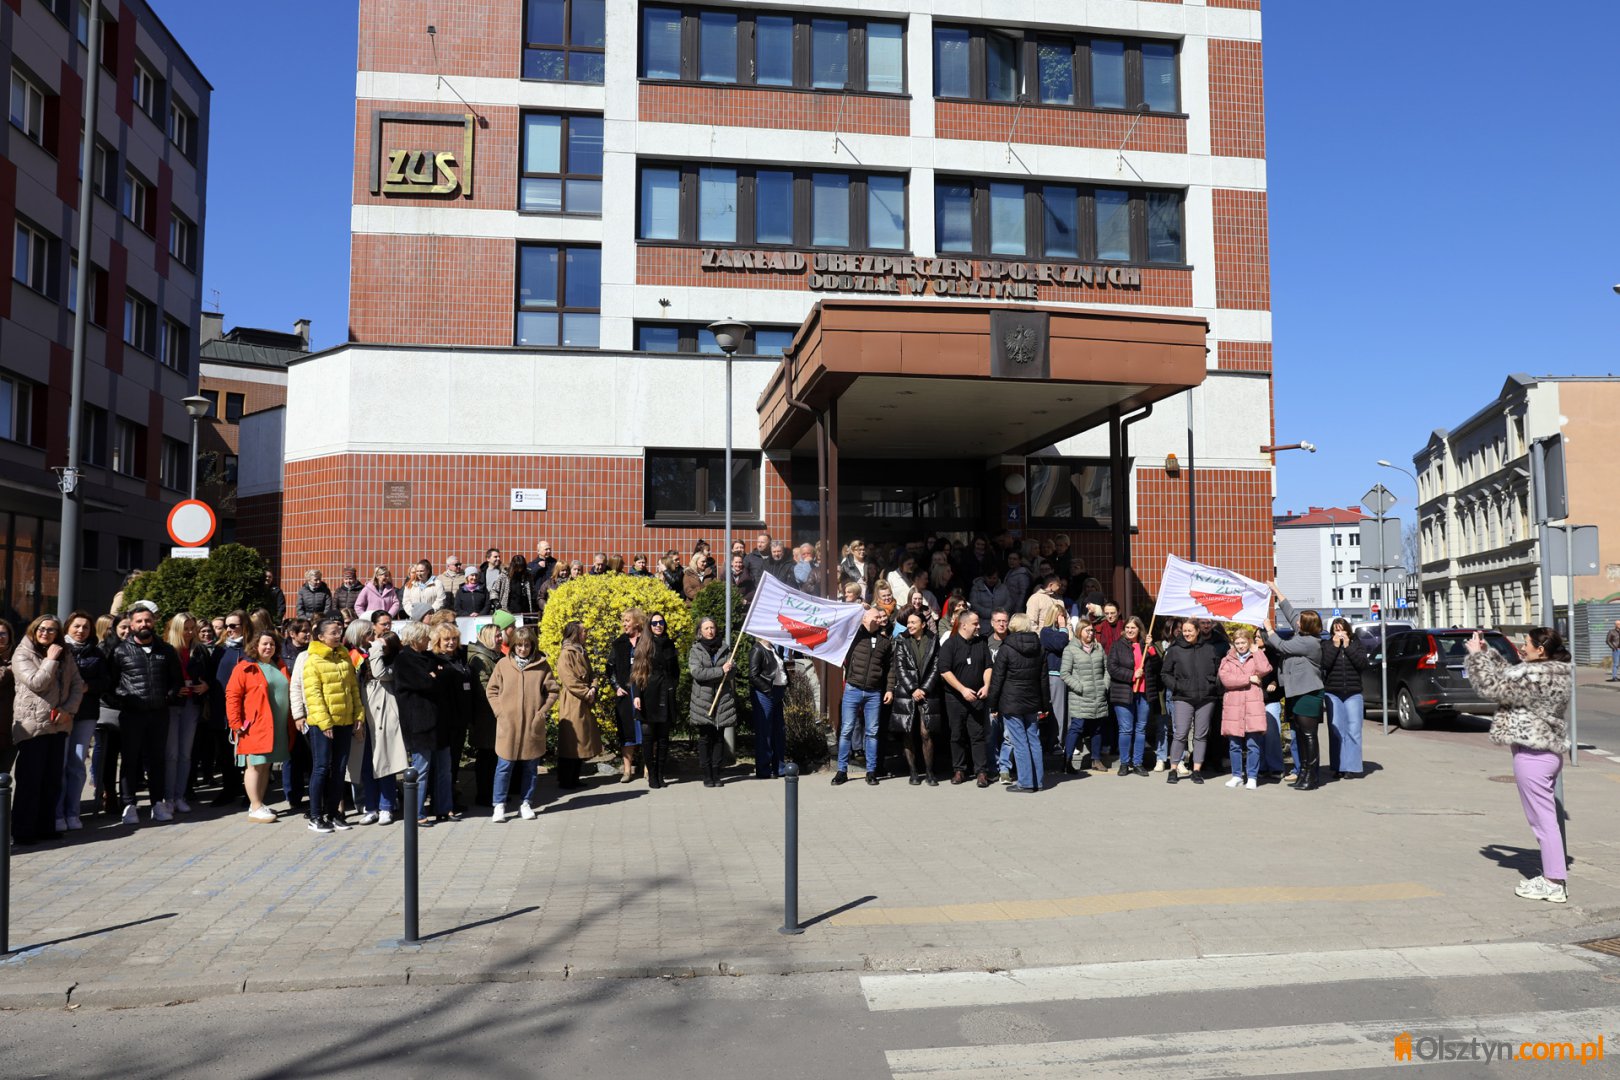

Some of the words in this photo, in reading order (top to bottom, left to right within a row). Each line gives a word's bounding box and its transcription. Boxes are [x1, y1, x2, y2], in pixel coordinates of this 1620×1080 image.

[382, 150, 458, 194] ZUS
[701, 249, 806, 272] ZAKŁAD
[979, 261, 1141, 287] SPOŁECZNYCH
[808, 274, 899, 292] ODDZIAŁ
[907, 277, 927, 294] W
[932, 279, 1038, 299] OLSZTYNIE
[1009, 509, 1018, 520] 4
[786, 596, 821, 615] KZZP
